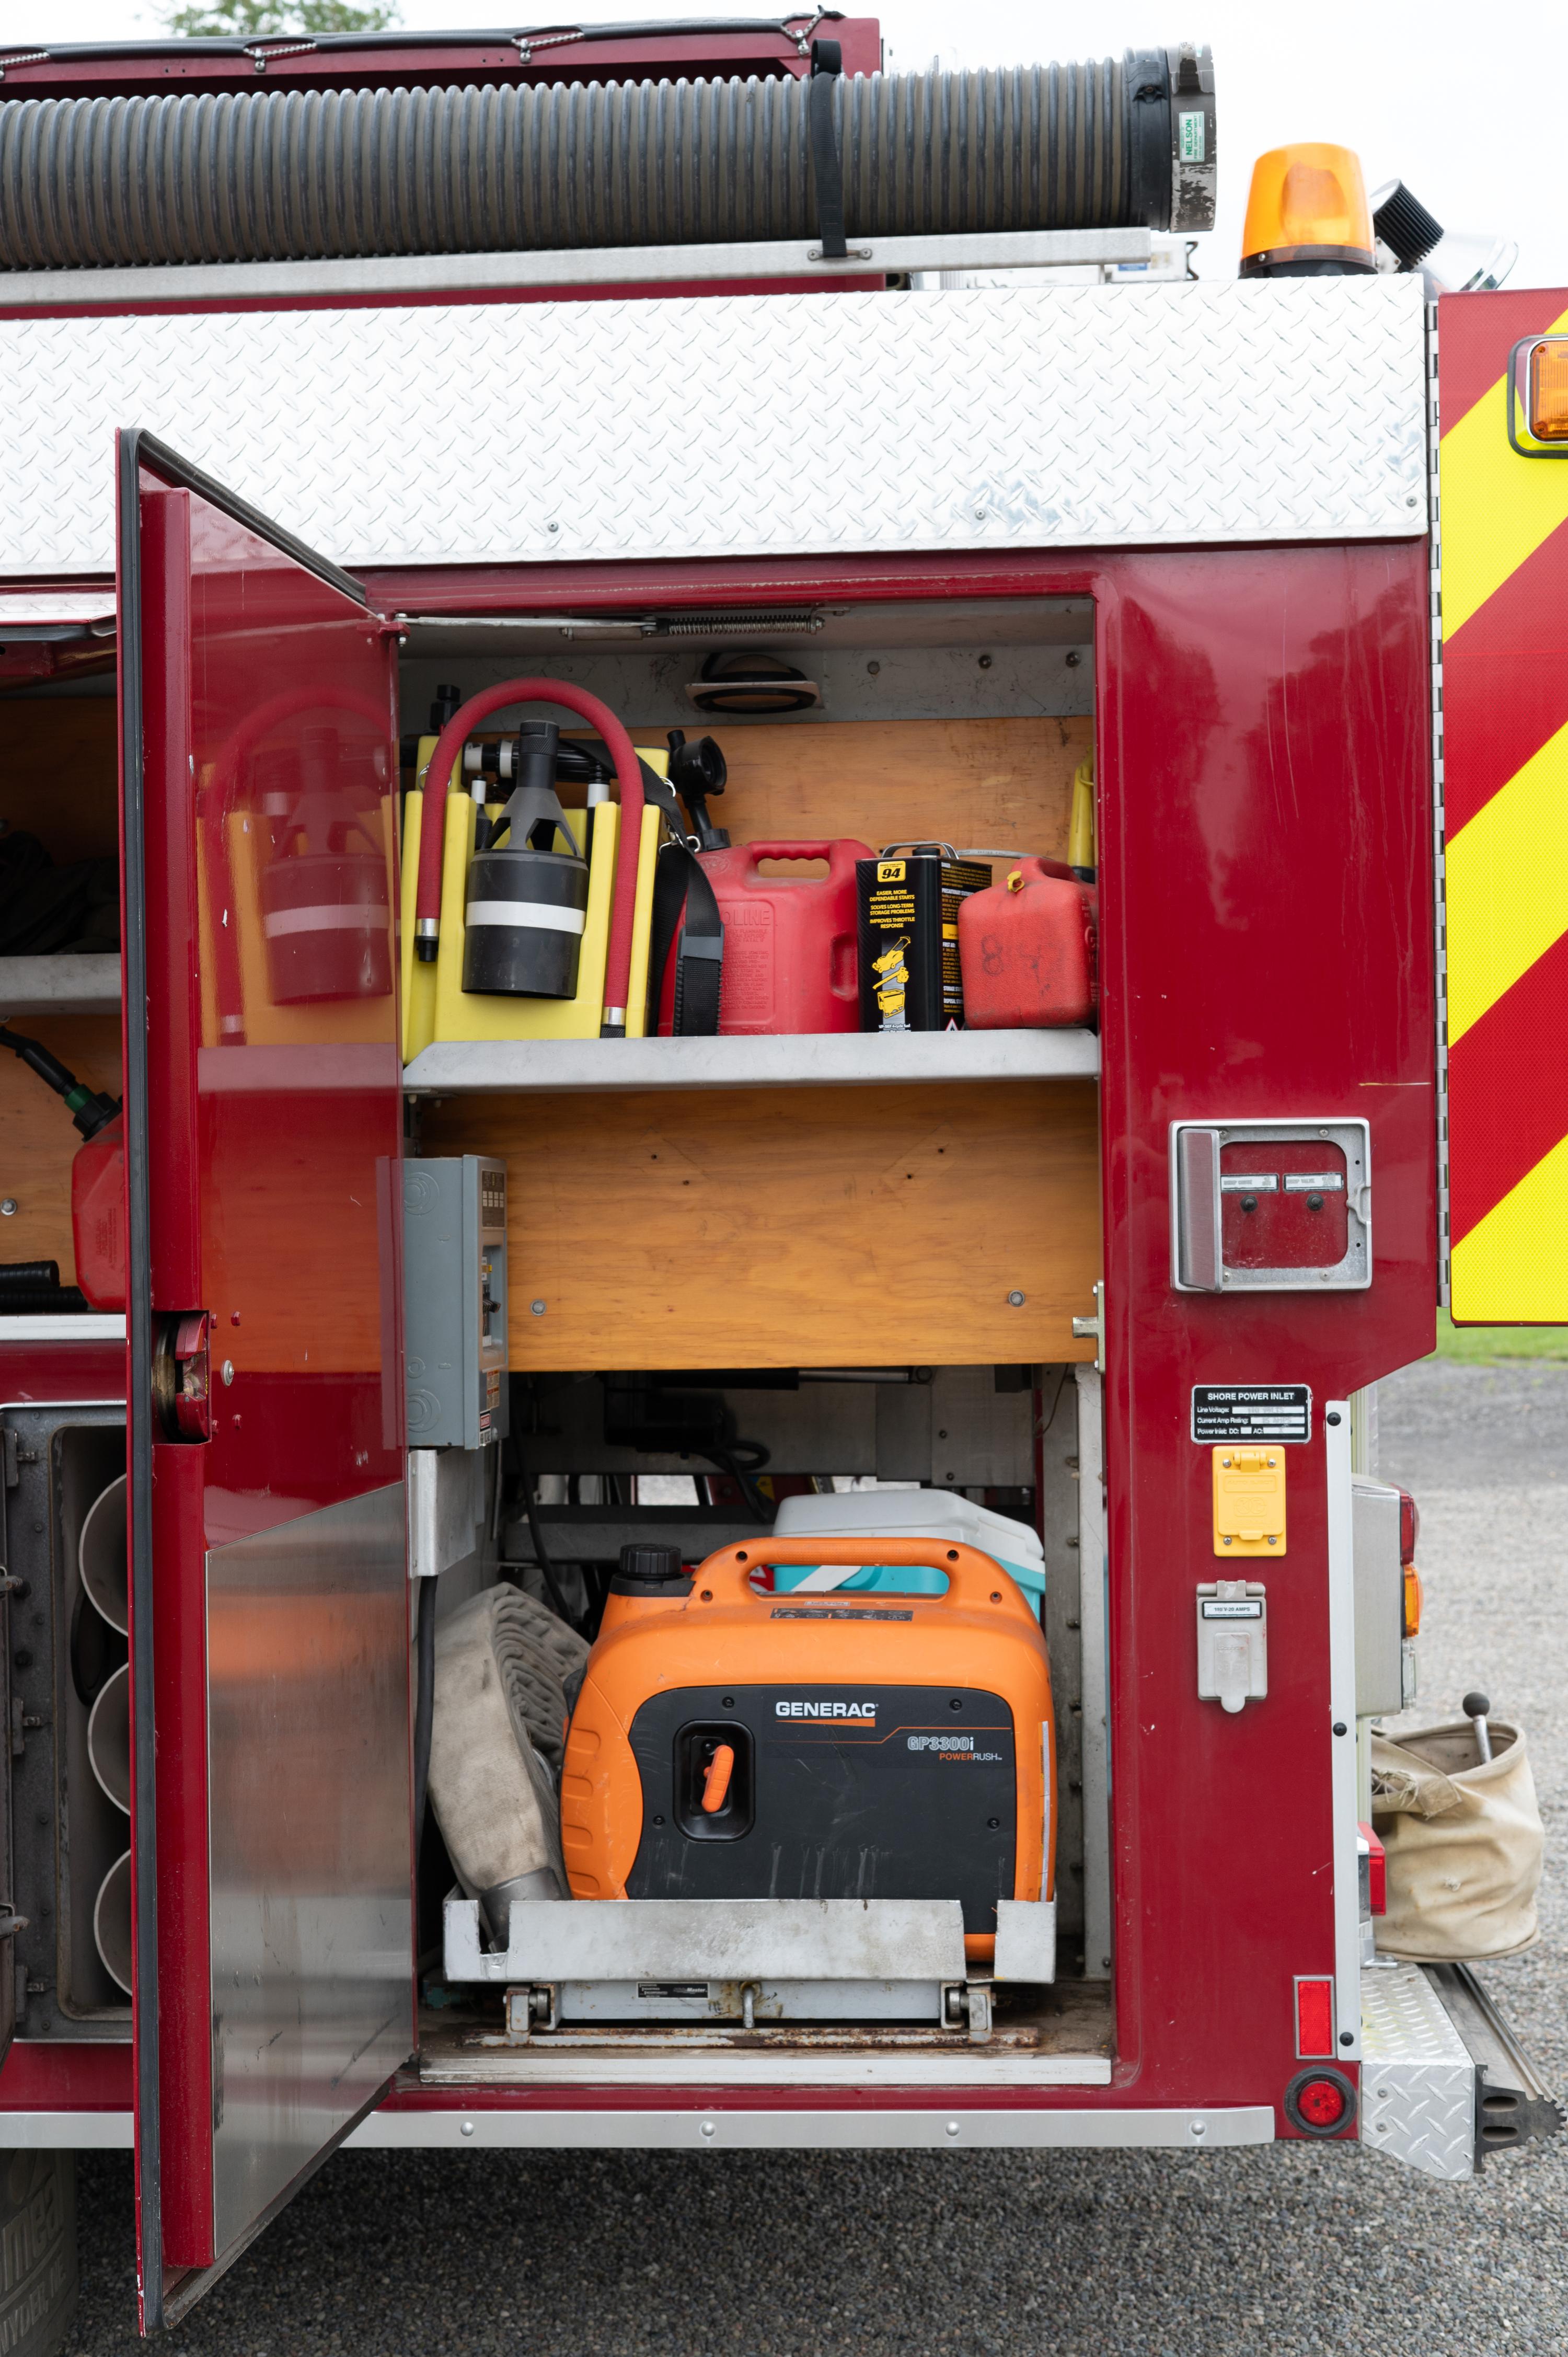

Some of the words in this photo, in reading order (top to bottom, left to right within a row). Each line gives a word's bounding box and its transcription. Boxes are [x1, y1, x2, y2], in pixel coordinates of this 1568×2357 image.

[882, 868, 901, 879] 94
[720, 910, 771, 926] OLINE
[1207, 1392, 1236, 1400] SHORE
[775, 1702, 876, 1717] GENERAC
[907, 1736, 974, 1751] GP3300i
